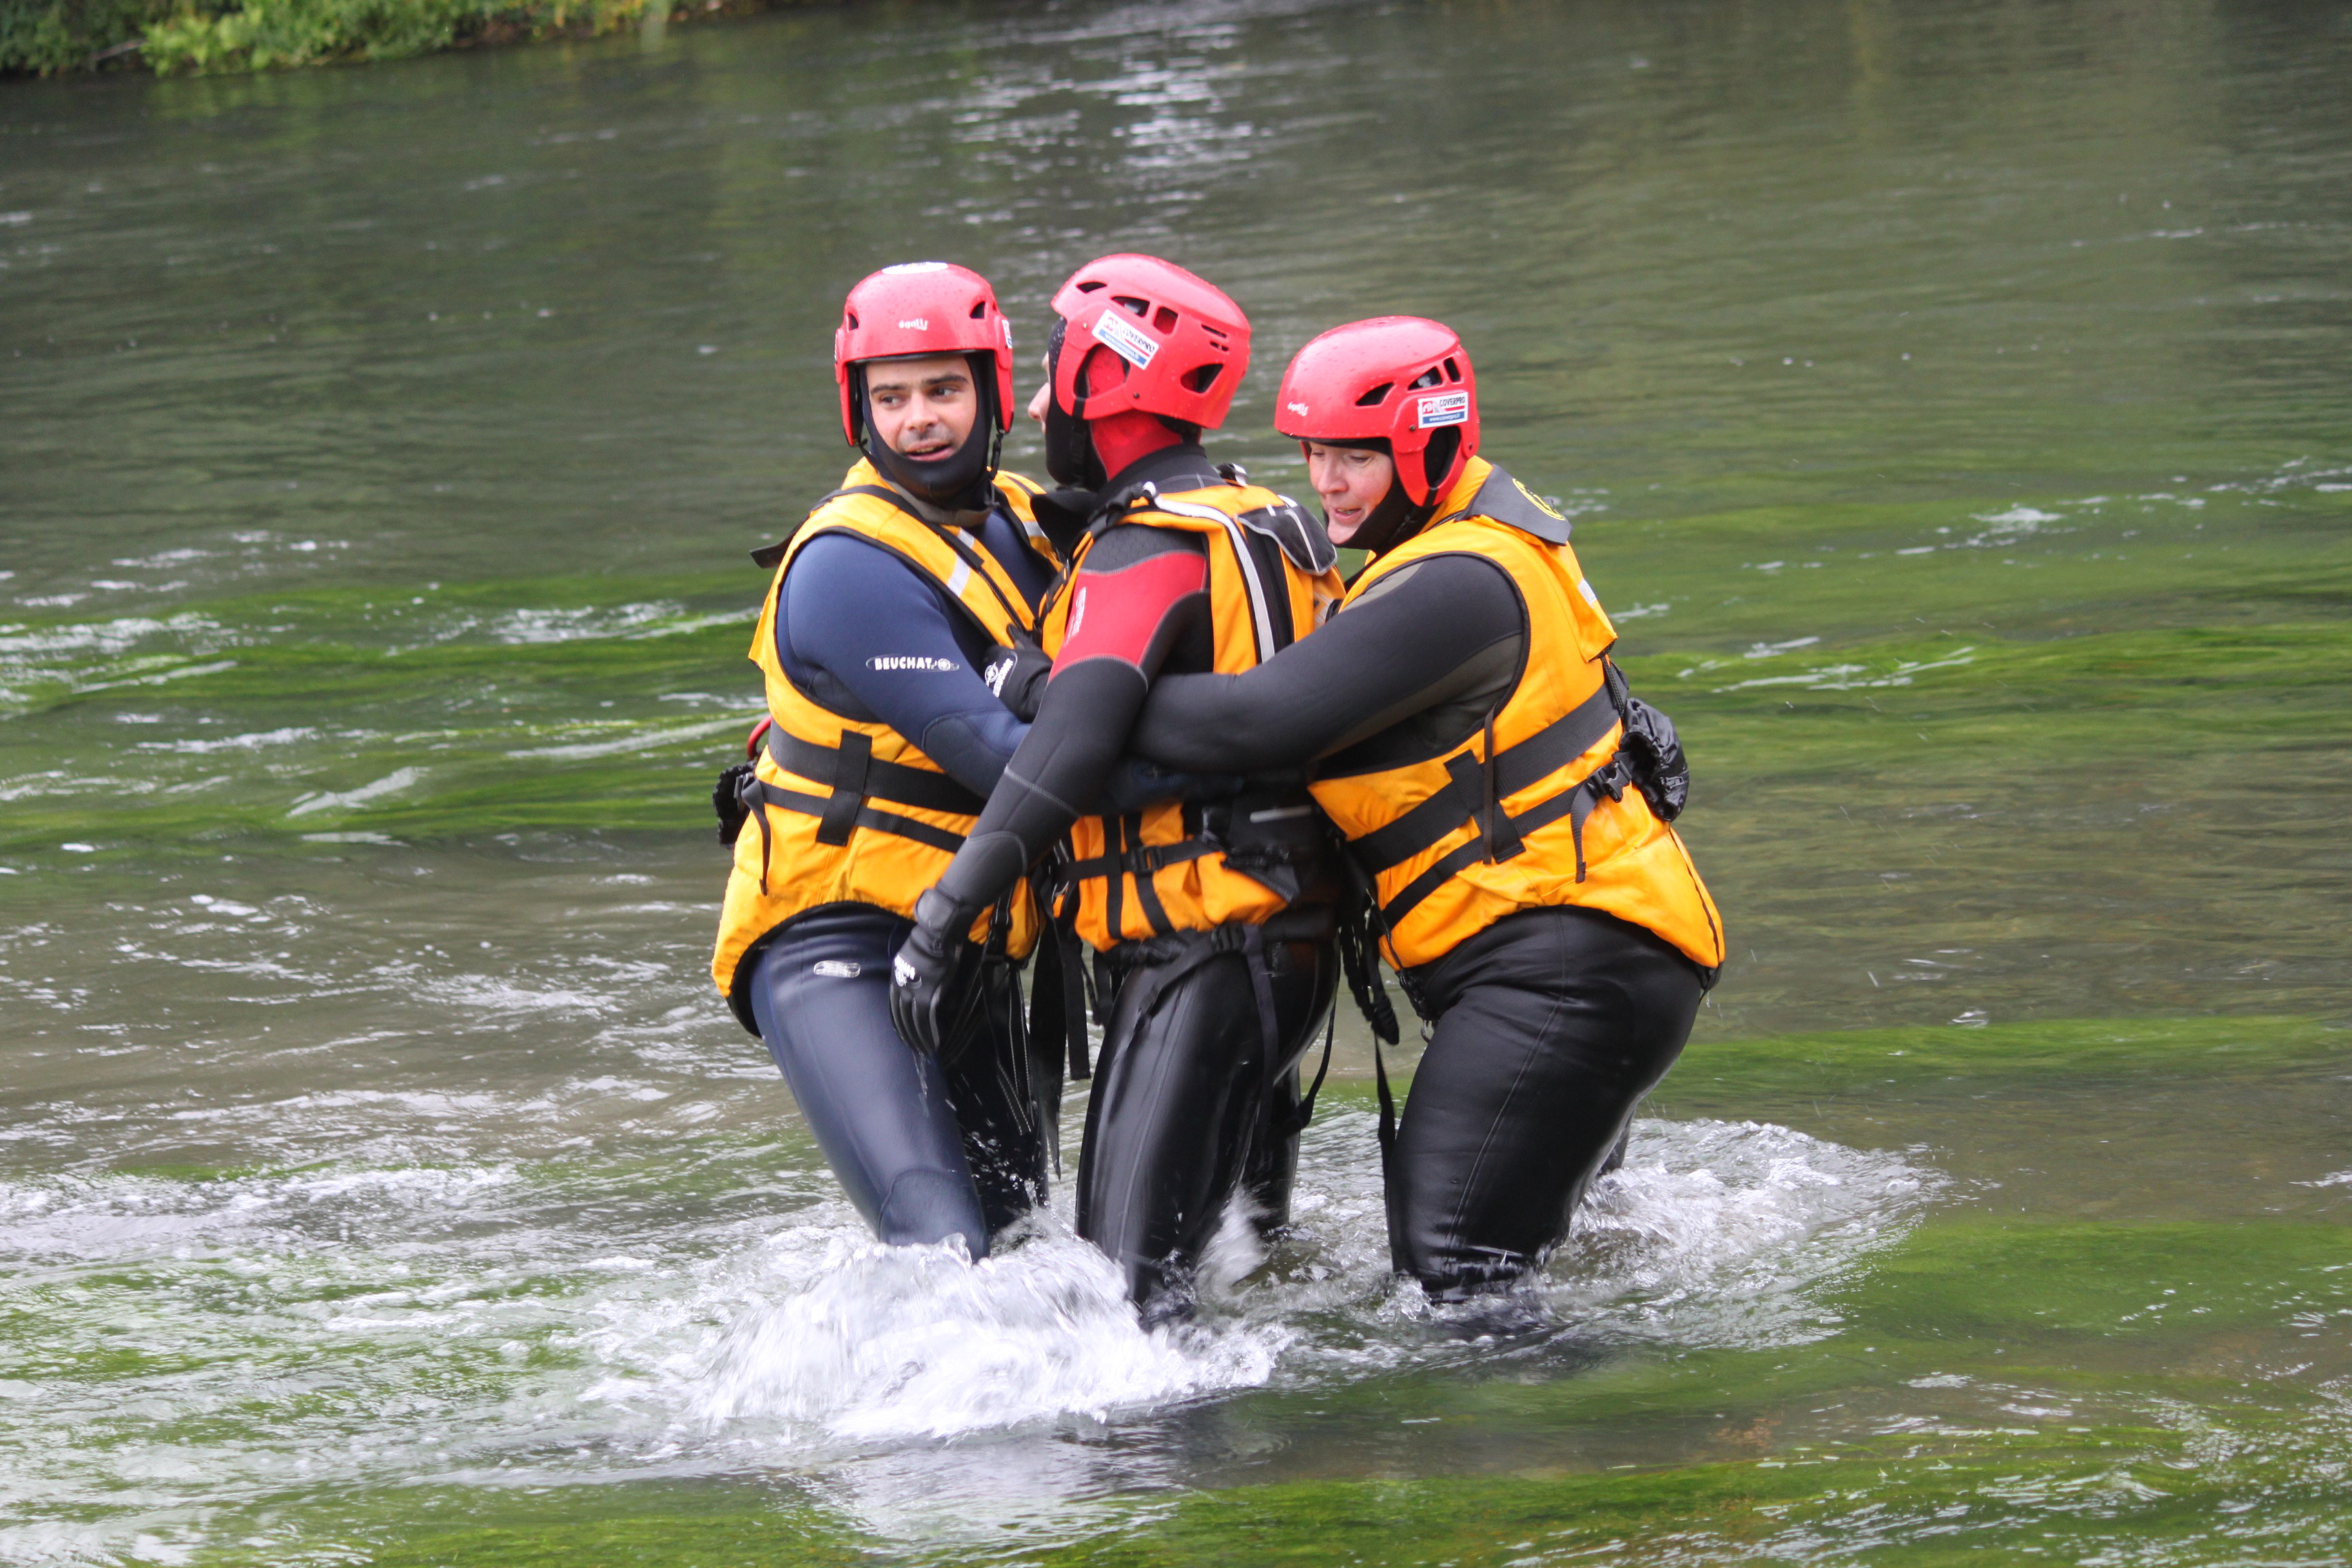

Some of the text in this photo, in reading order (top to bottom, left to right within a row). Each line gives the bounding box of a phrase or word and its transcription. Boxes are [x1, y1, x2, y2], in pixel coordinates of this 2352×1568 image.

[1122, 327, 1155, 353] COVERPRO
[1439, 396, 1466, 408] COVERPRO
[875, 656, 932, 670] BEUCHAT
